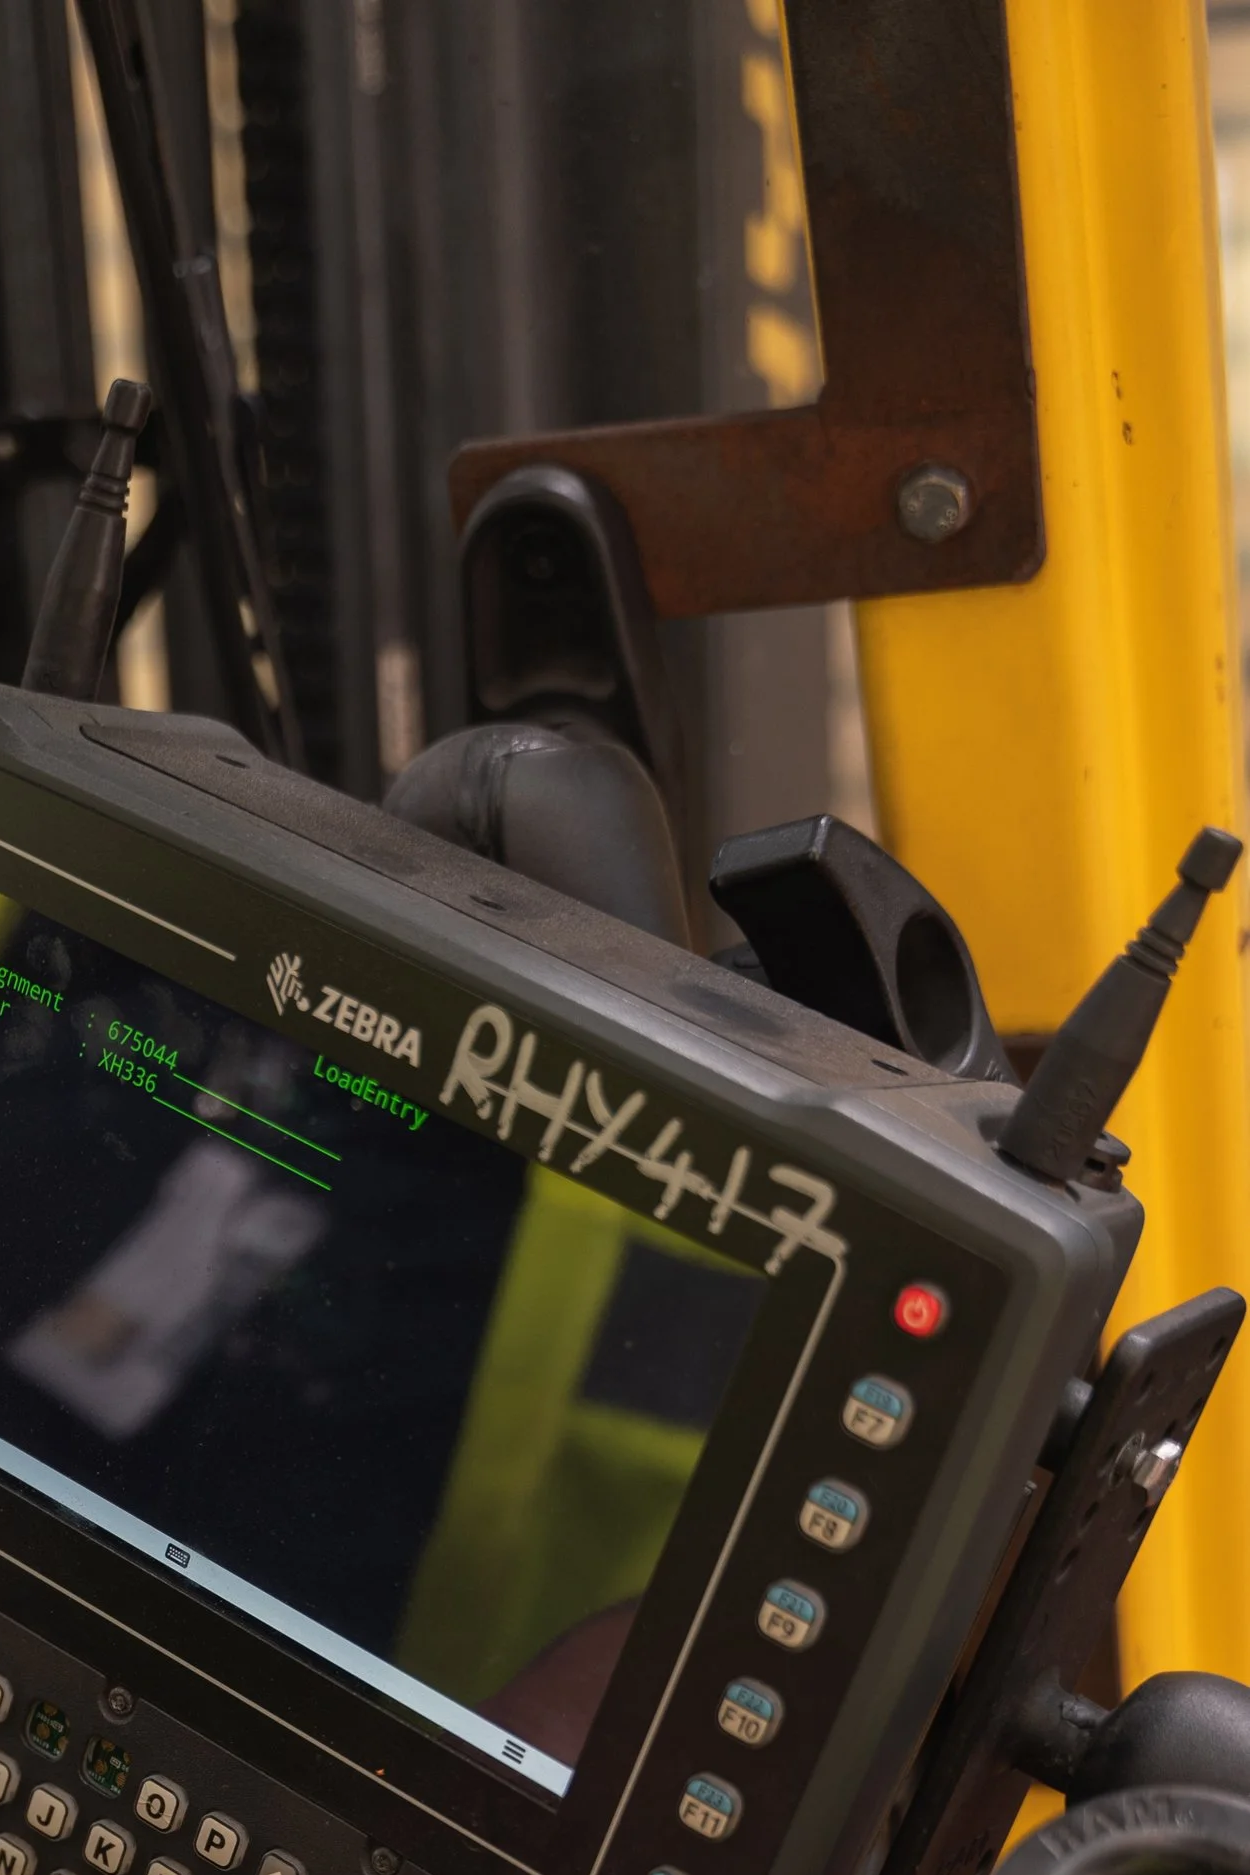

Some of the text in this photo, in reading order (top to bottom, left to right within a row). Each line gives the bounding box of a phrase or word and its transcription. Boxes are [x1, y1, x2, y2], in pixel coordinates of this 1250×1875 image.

[108, 1020, 178, 1070] 675044
[311, 985, 422, 1069] ZEBRA
[98, 1048, 158, 1094] XH336
[313, 1054, 430, 1131] LoadEntry
[438, 1003, 848, 1276] RHY417
[851, 1407, 884, 1435] F7
[809, 1511, 839, 1541] F8
[766, 1612, 795, 1638] F9
[722, 1706, 760, 1739] F10
[36, 1805, 55, 1827] J
[93, 1837, 116, 1866] K
[145, 1793, 166, 1820] O
[204, 1828, 226, 1854] P
[684, 1802, 721, 1834] F11
